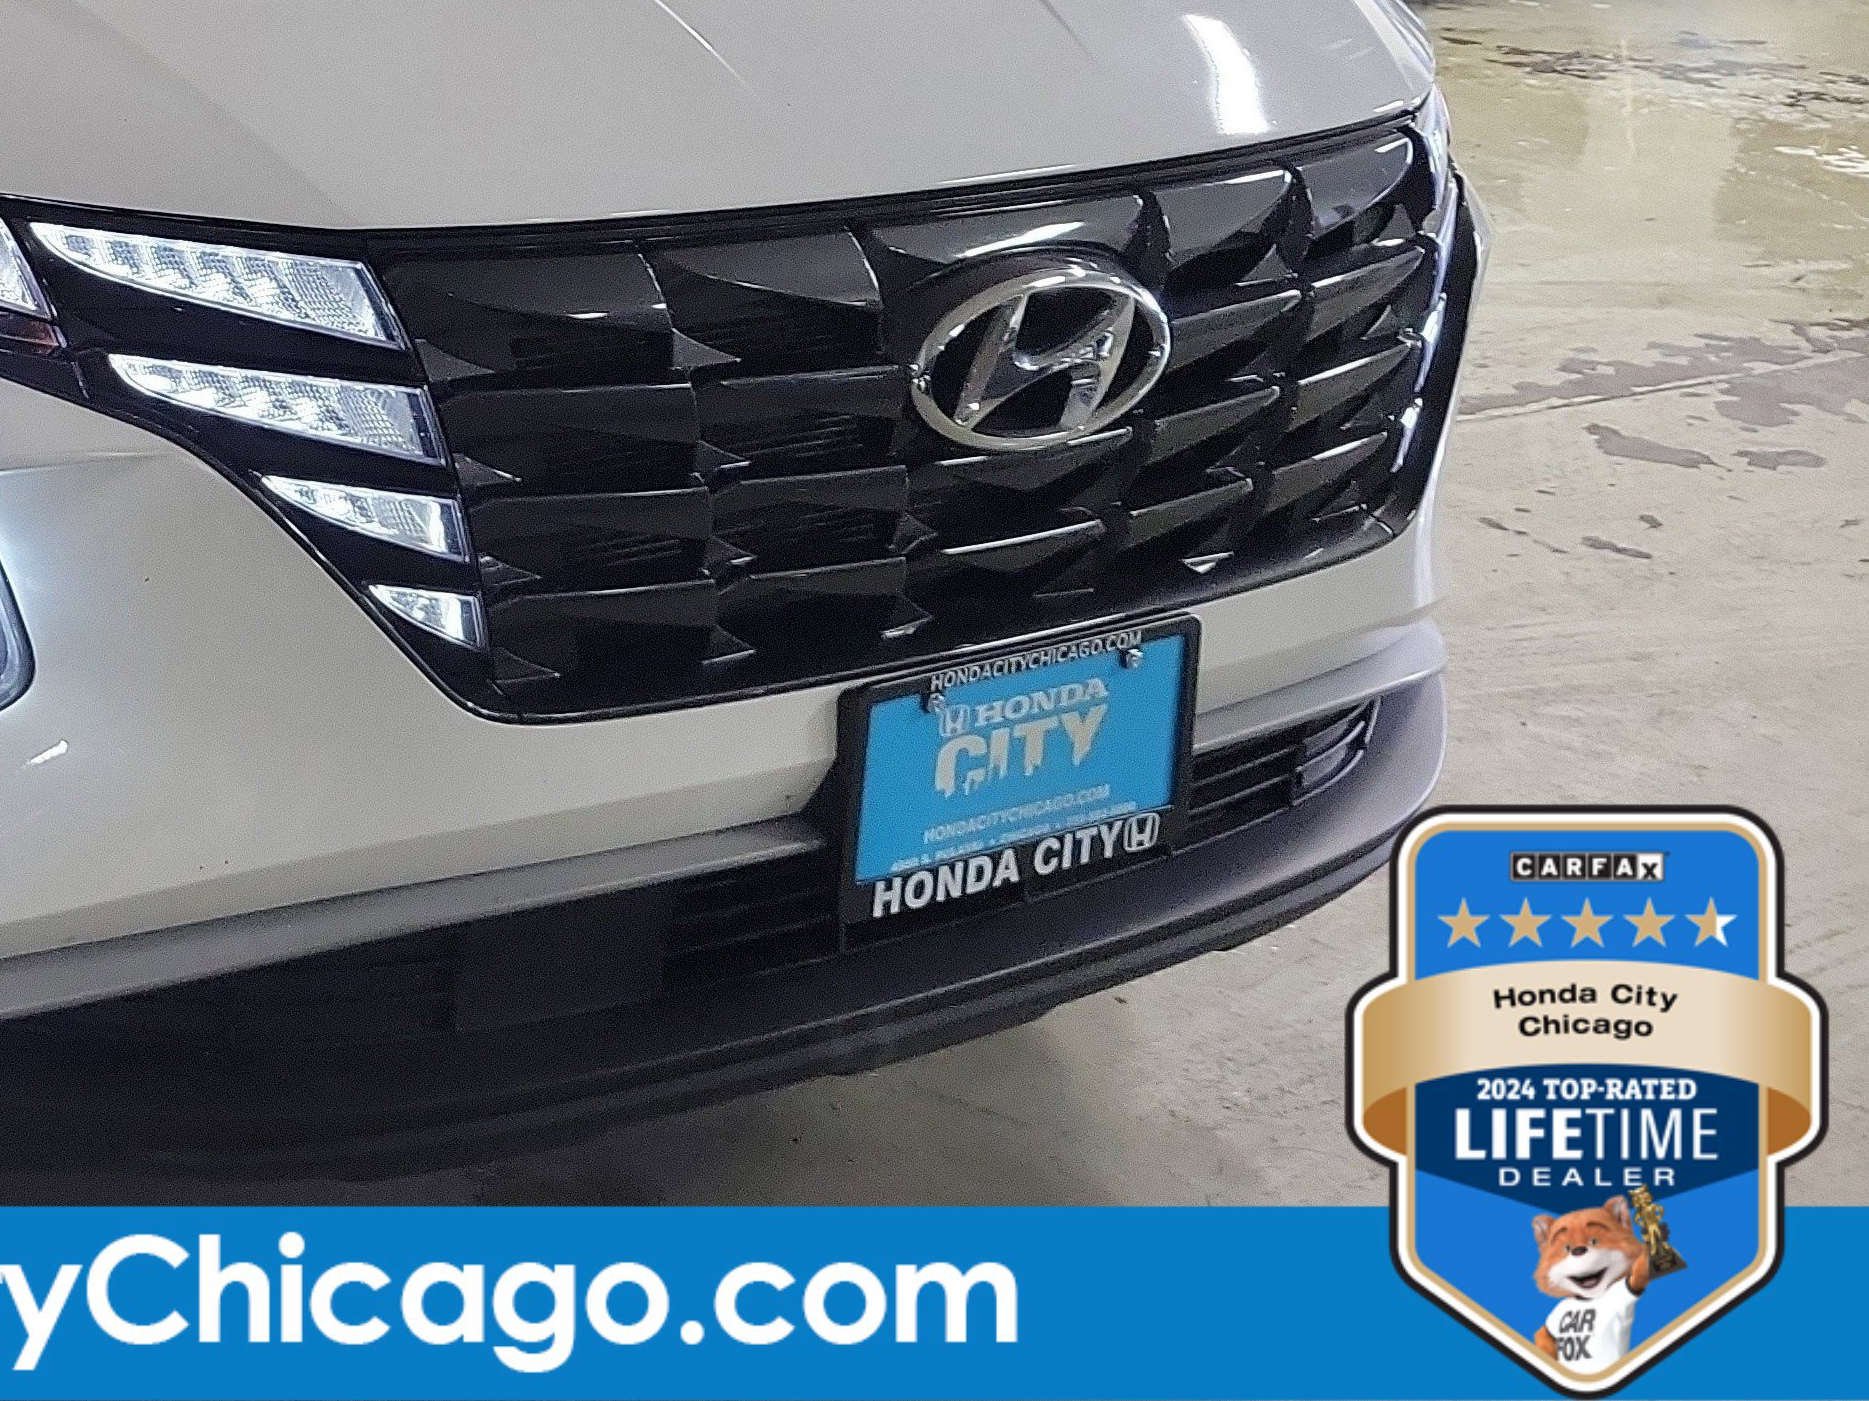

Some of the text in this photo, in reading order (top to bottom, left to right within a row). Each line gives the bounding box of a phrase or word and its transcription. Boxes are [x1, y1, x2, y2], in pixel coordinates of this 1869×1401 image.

[930, 629, 1143, 692] HONDACITYCHICAGO.COM
[974, 678, 1109, 728] HONDA
[934, 704, 1109, 799] CITY
[872, 848, 1020, 920] HONDA
[1033, 820, 1124, 876] CITY
